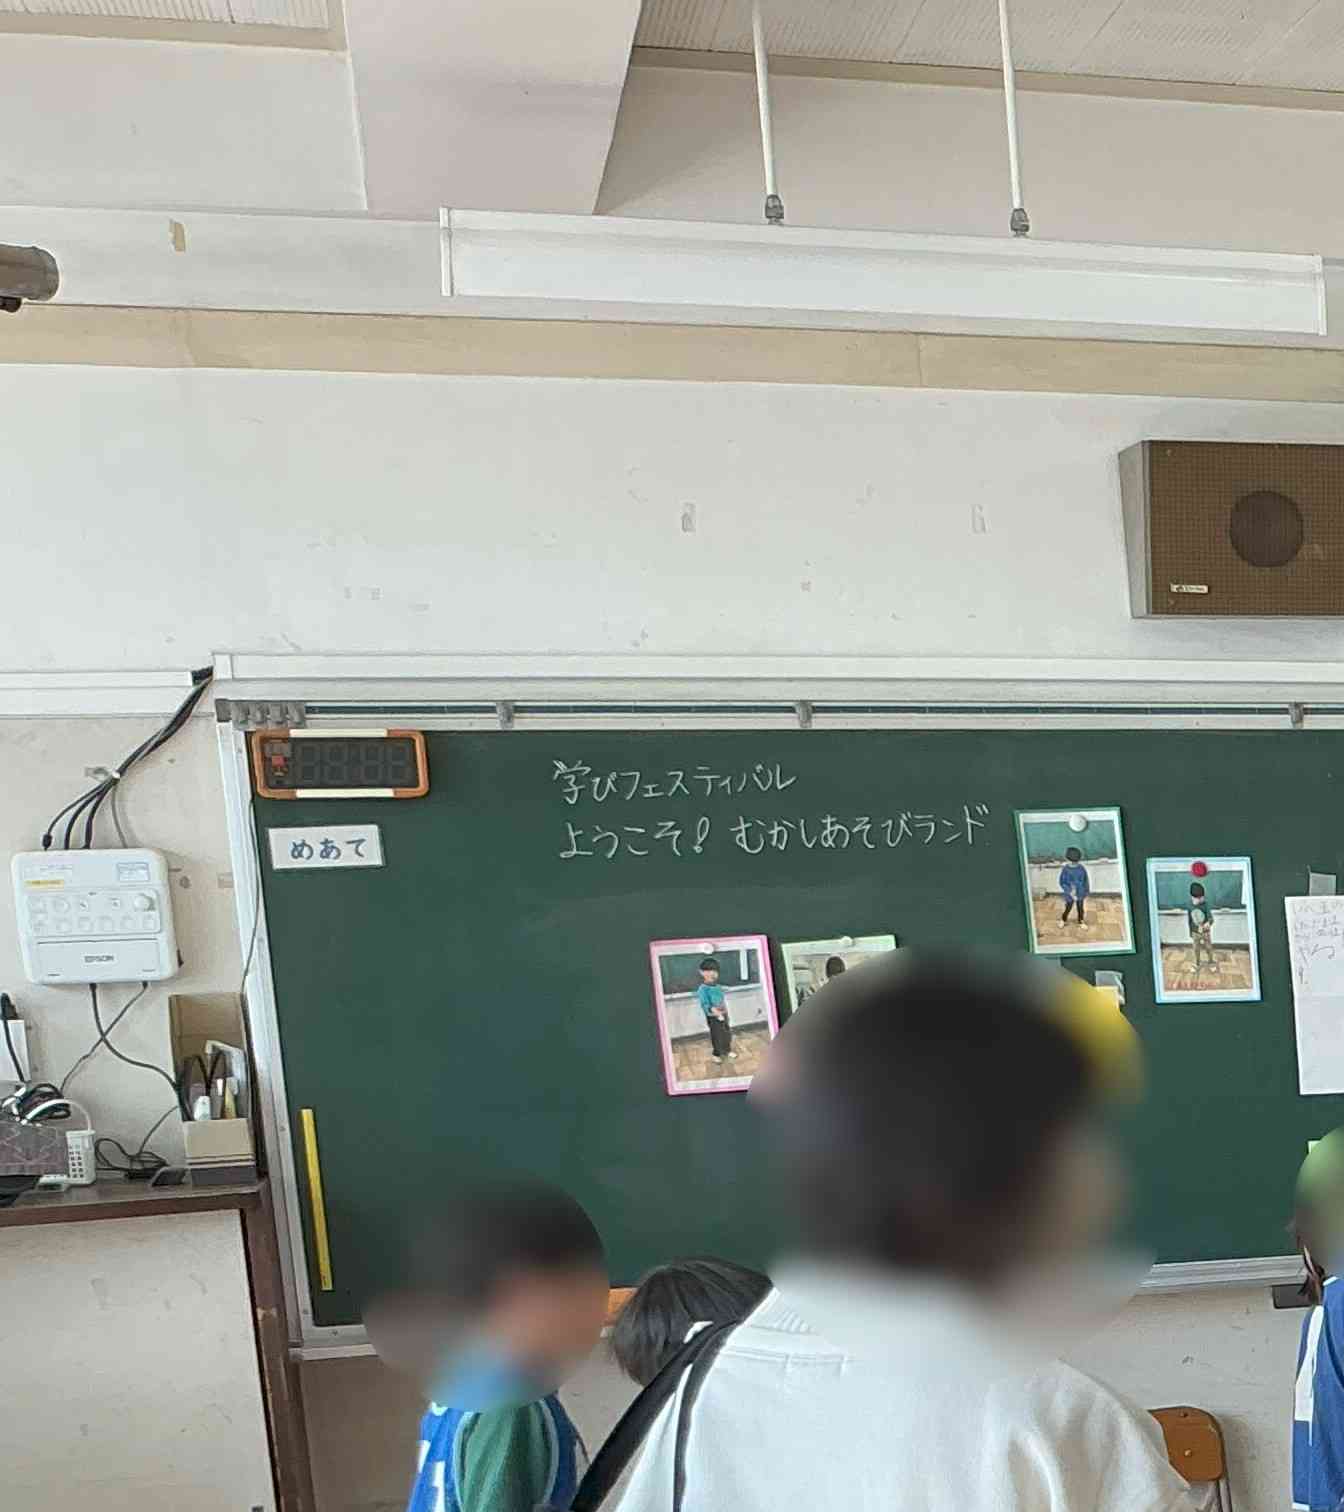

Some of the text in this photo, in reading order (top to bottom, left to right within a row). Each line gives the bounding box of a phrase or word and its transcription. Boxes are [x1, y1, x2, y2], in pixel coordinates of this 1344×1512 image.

[552, 759, 799, 806] 学びフェスティバル
[288, 835, 369, 864] めあて
[728, 803, 992, 855] むかしあそびランド
